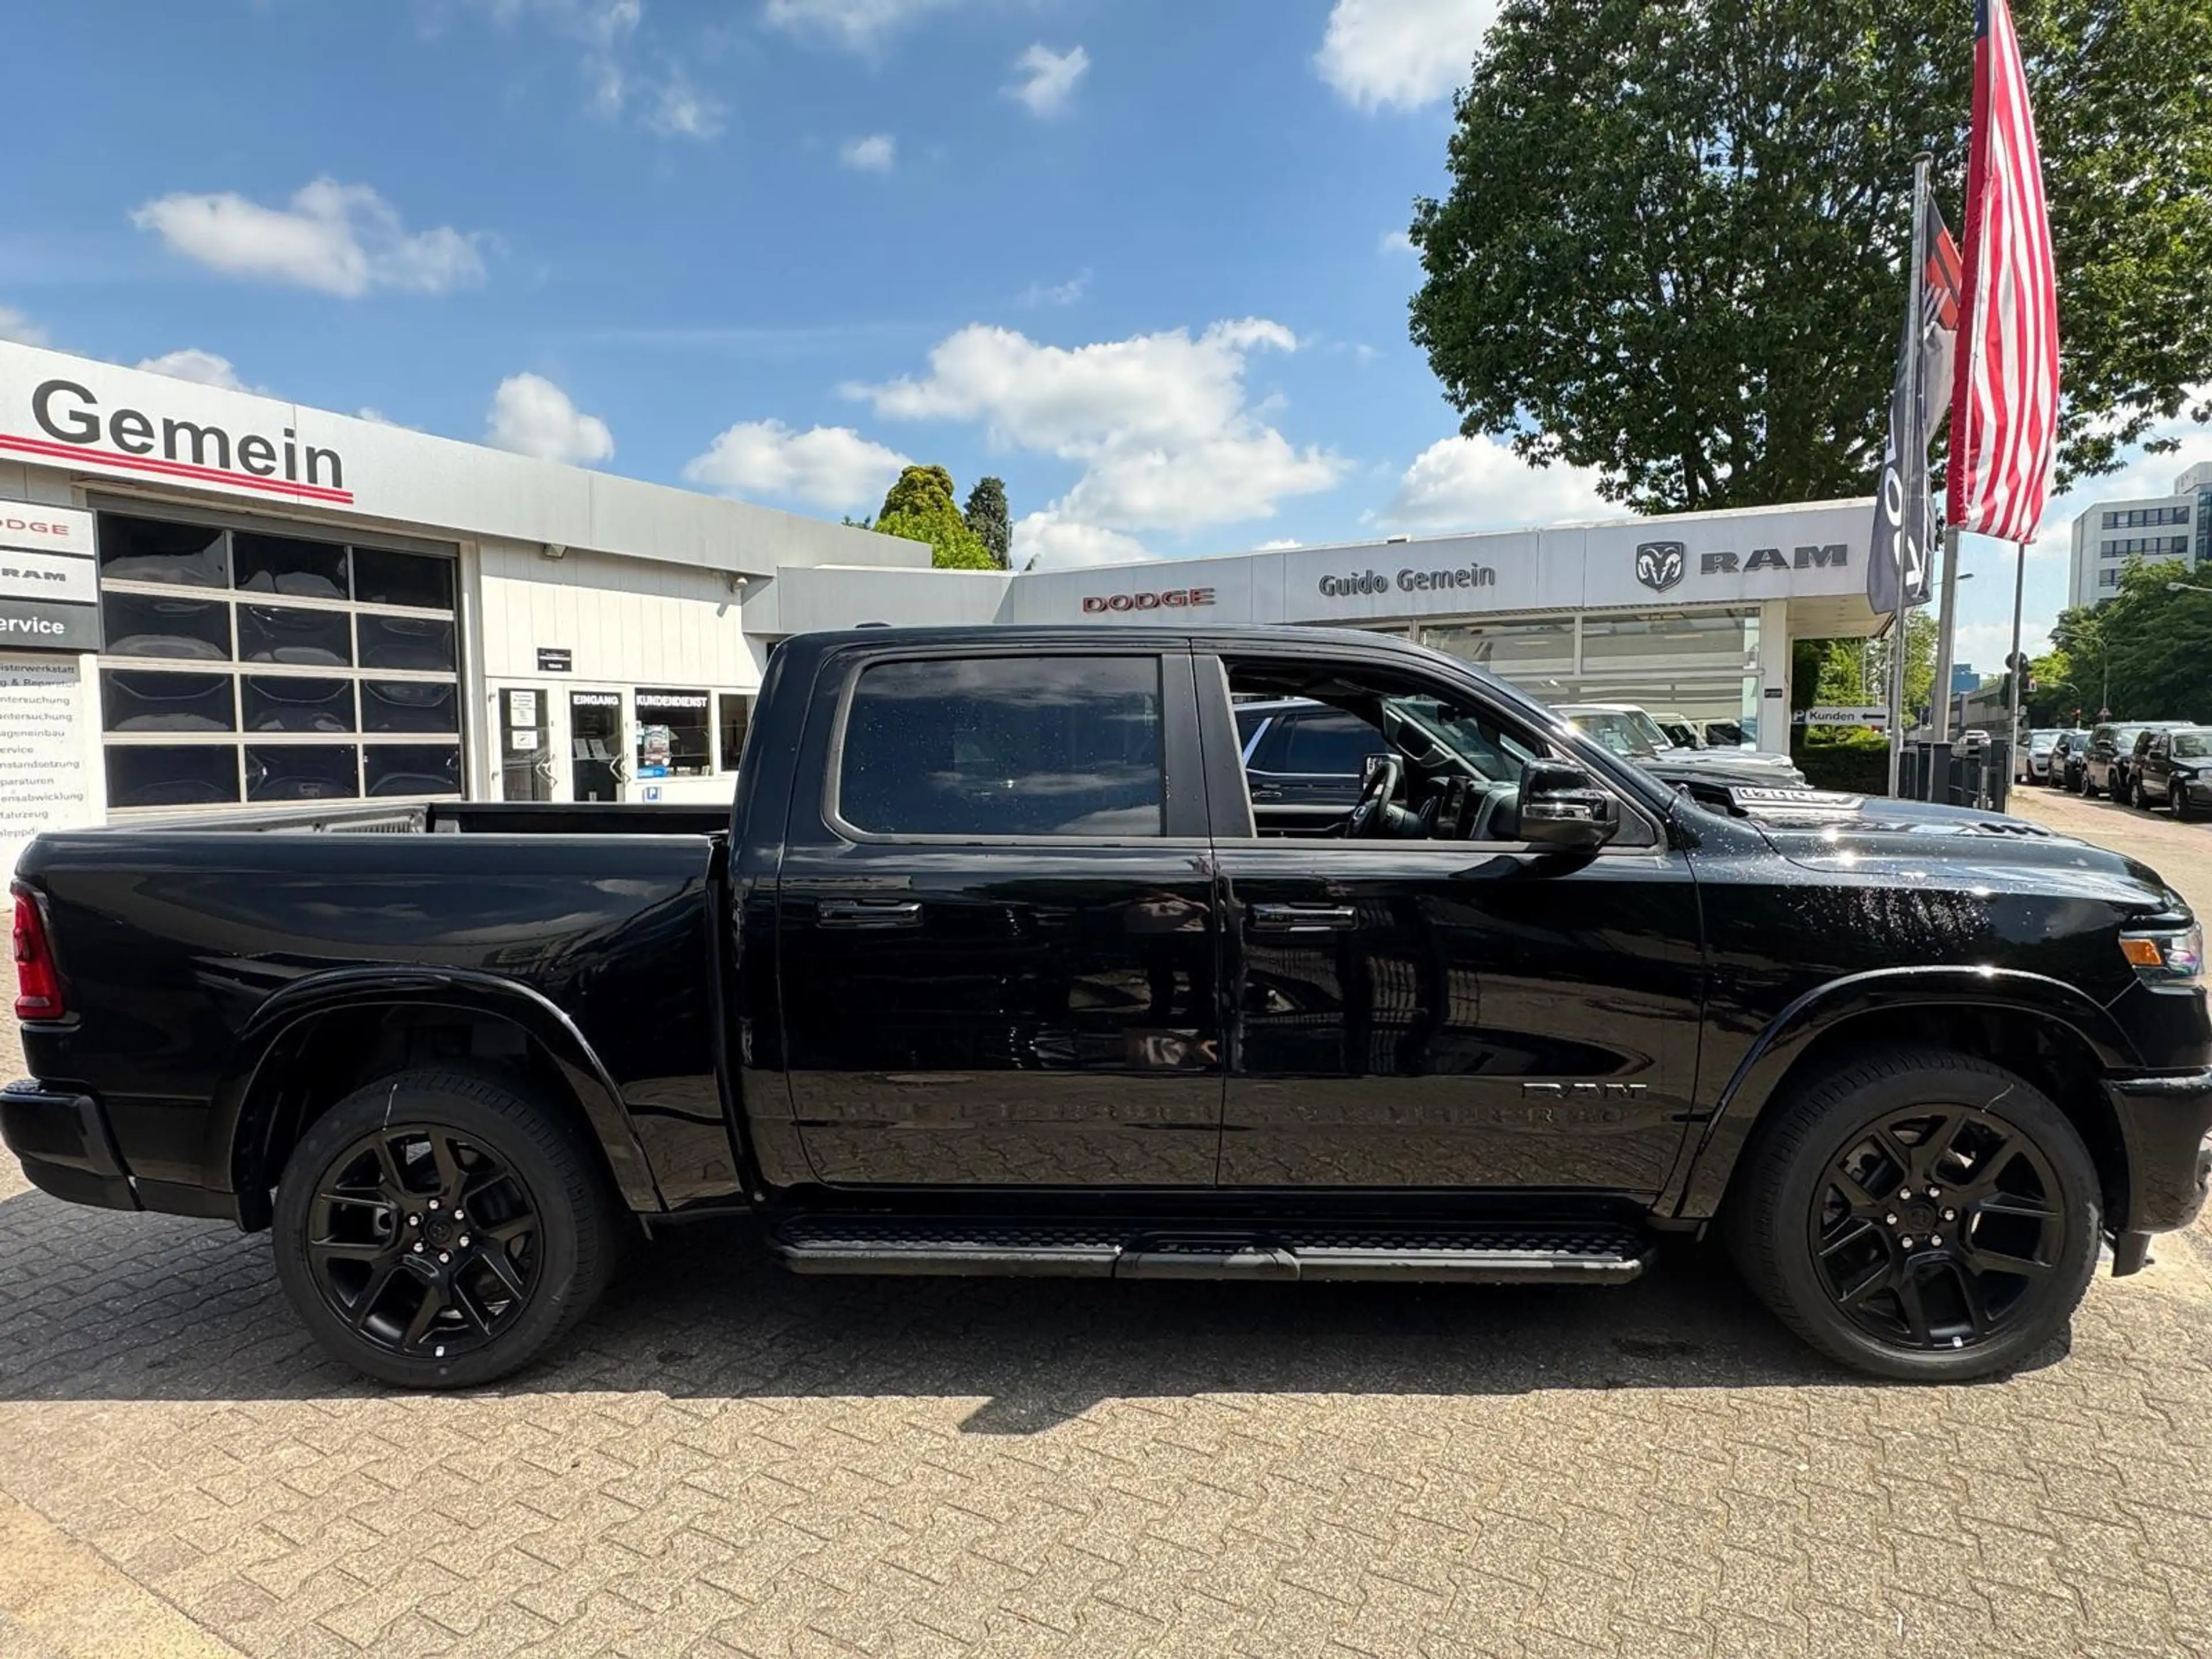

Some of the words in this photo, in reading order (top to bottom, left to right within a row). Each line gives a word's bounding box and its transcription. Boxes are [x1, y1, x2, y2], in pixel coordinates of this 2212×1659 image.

[32, 378, 343, 489] Gemein
[0, 518, 69, 536] DGE
[1700, 544, 1847, 574] RAM
[2, 567, 66, 582] RAM
[1319, 569, 1388, 596] Guido
[1396, 563, 1495, 591] Gemein
[1082, 588, 1216, 612] DODGE
[573, 695, 619, 706] EINGANG
[635, 695, 708, 707] KUNDENDIENST
[1809, 711, 1855, 721] Kunden
[1521, 1084, 1647, 1099] RAM
